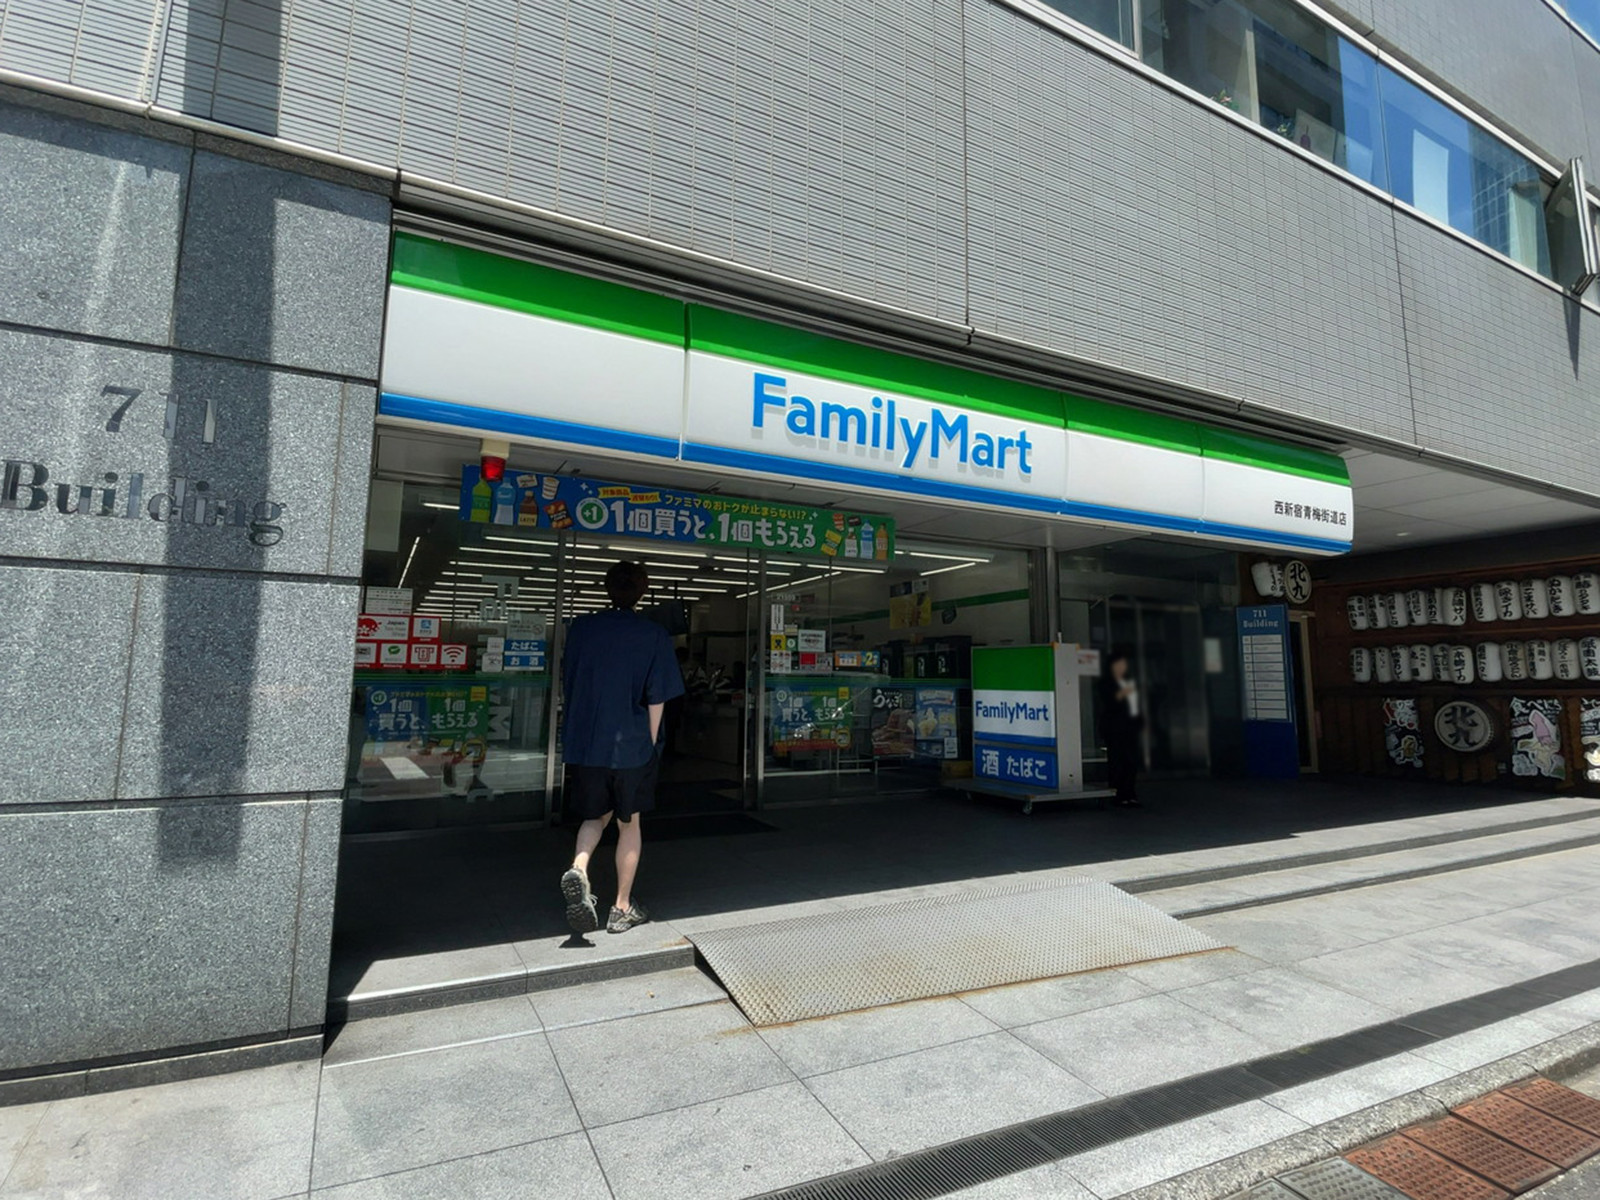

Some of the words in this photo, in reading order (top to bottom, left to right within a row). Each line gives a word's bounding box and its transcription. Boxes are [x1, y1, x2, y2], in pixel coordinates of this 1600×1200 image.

[101, 384, 218, 444] 711
[752, 372, 1032, 474] FamilyMart
[2, 459, 287, 547] Building
[664, 494, 807, 520] ファミマのおトクが止まらない!?
[1273, 500, 1347, 526] 西新宿青梅街道店
[1290, 563, 1307, 599] 北九
[1243, 620, 1279, 629] Building
[1252, 609, 1267, 618] 711
[510, 641, 539, 651] たばこ
[510, 656, 520, 666] お
[431, 712, 478, 730] もらえる
[975, 701, 1049, 724] FamilyMart
[982, 749, 999, 777] 酒
[1006, 755, 1048, 780] たばこ
